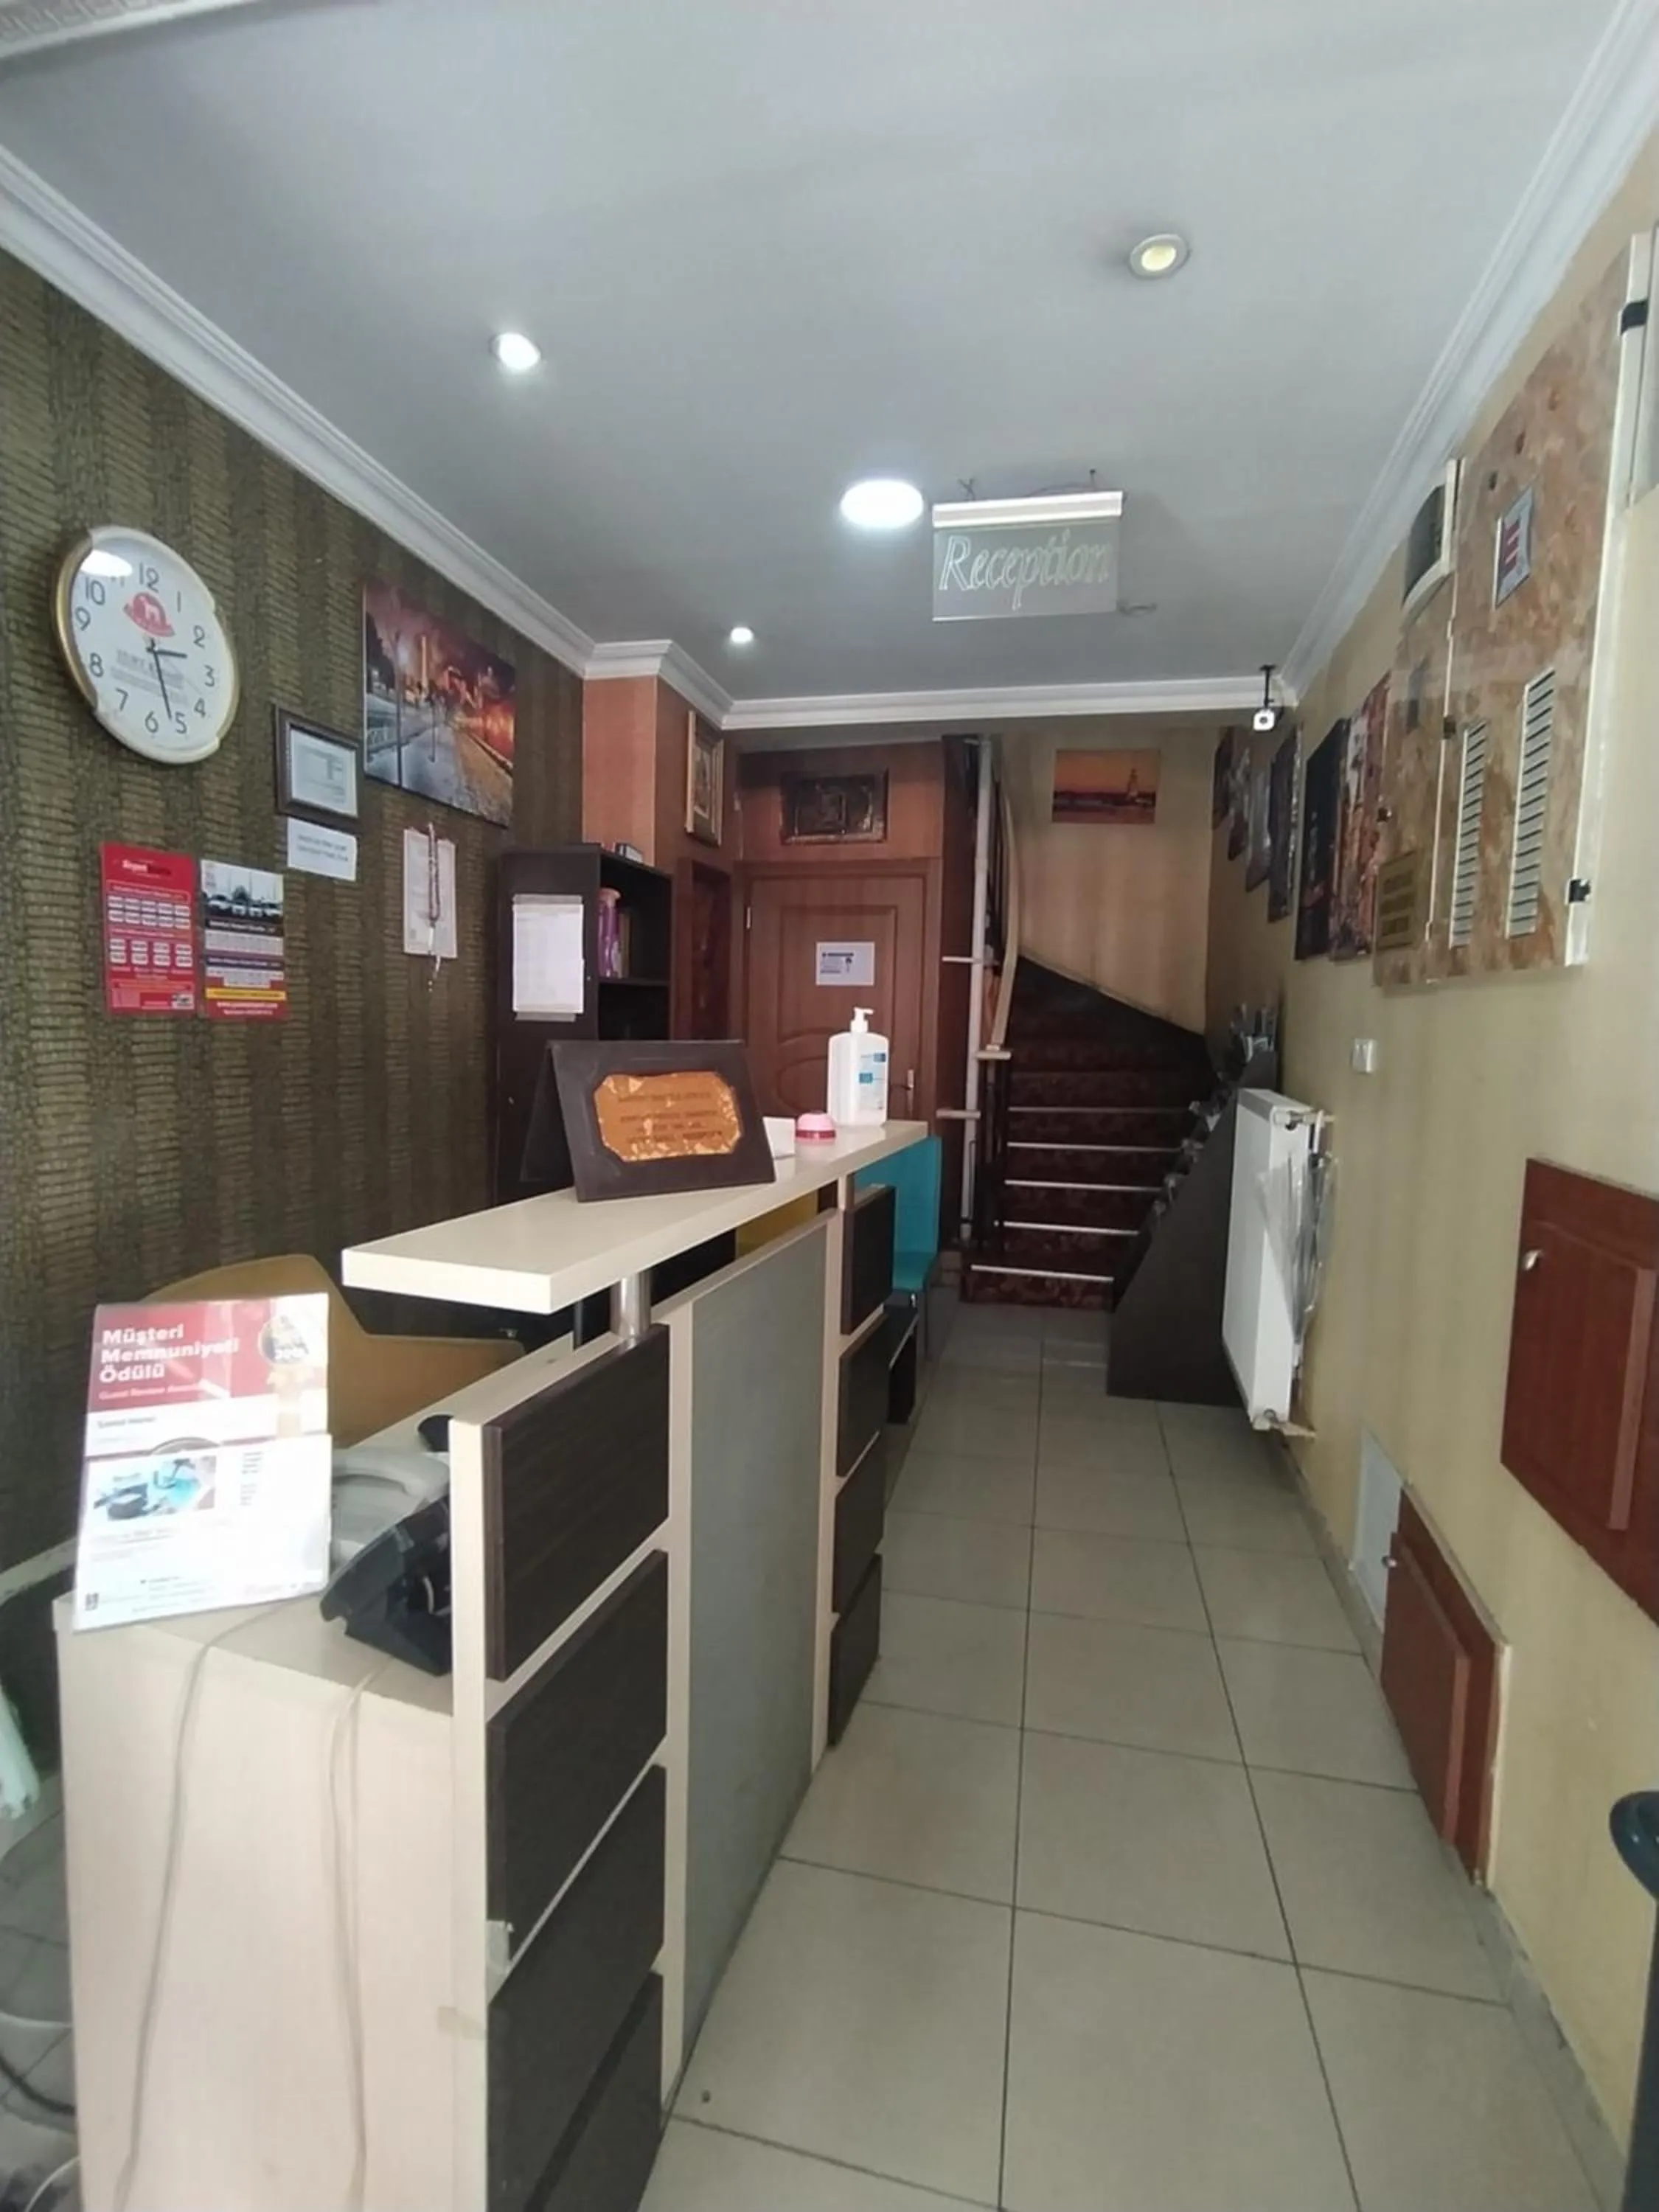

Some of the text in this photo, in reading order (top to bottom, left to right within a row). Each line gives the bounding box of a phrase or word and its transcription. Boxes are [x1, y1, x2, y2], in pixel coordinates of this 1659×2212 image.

[139, 562, 159, 592] 12
[939, 528, 1112, 611] Reception
[85, 577, 105, 606] 10
[75, 607, 91, 631] 9
[193, 625, 205, 649] 2
[90, 653, 103, 678] 8
[204, 665, 215, 687] 3
[116, 688, 128, 712] 7
[194, 698, 206, 718] 4
[145, 711, 159, 734] 6
[175, 712, 187, 734] 5
[102, 1324, 184, 1346] Müşteri
[99, 1363, 165, 1383] Ödülü
